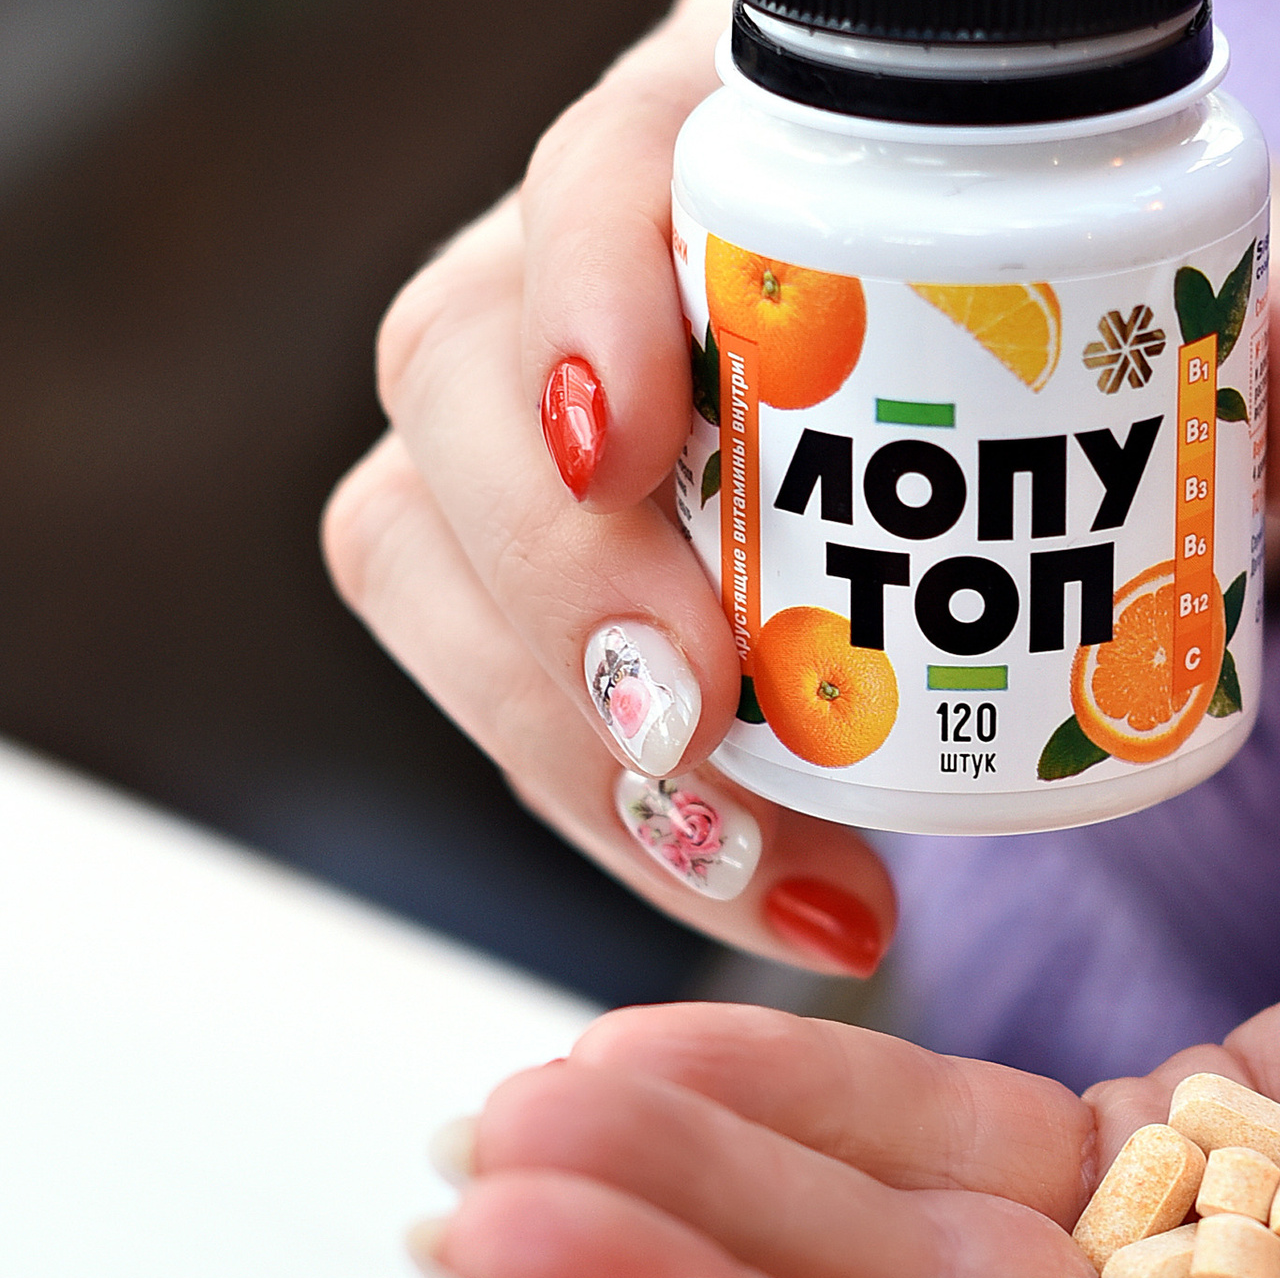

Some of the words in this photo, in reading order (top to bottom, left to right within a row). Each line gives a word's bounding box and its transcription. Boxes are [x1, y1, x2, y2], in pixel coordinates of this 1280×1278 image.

[727, 351, 749, 433] внутри!
[732, 438, 747, 544] витамины
[773, 414, 1165, 542] ЛОПУ
[825, 541, 1115, 657] ТОП
[1184, 646, 1201, 671] C
[936, 701, 998, 743] 120
[940, 752, 997, 780] штук
